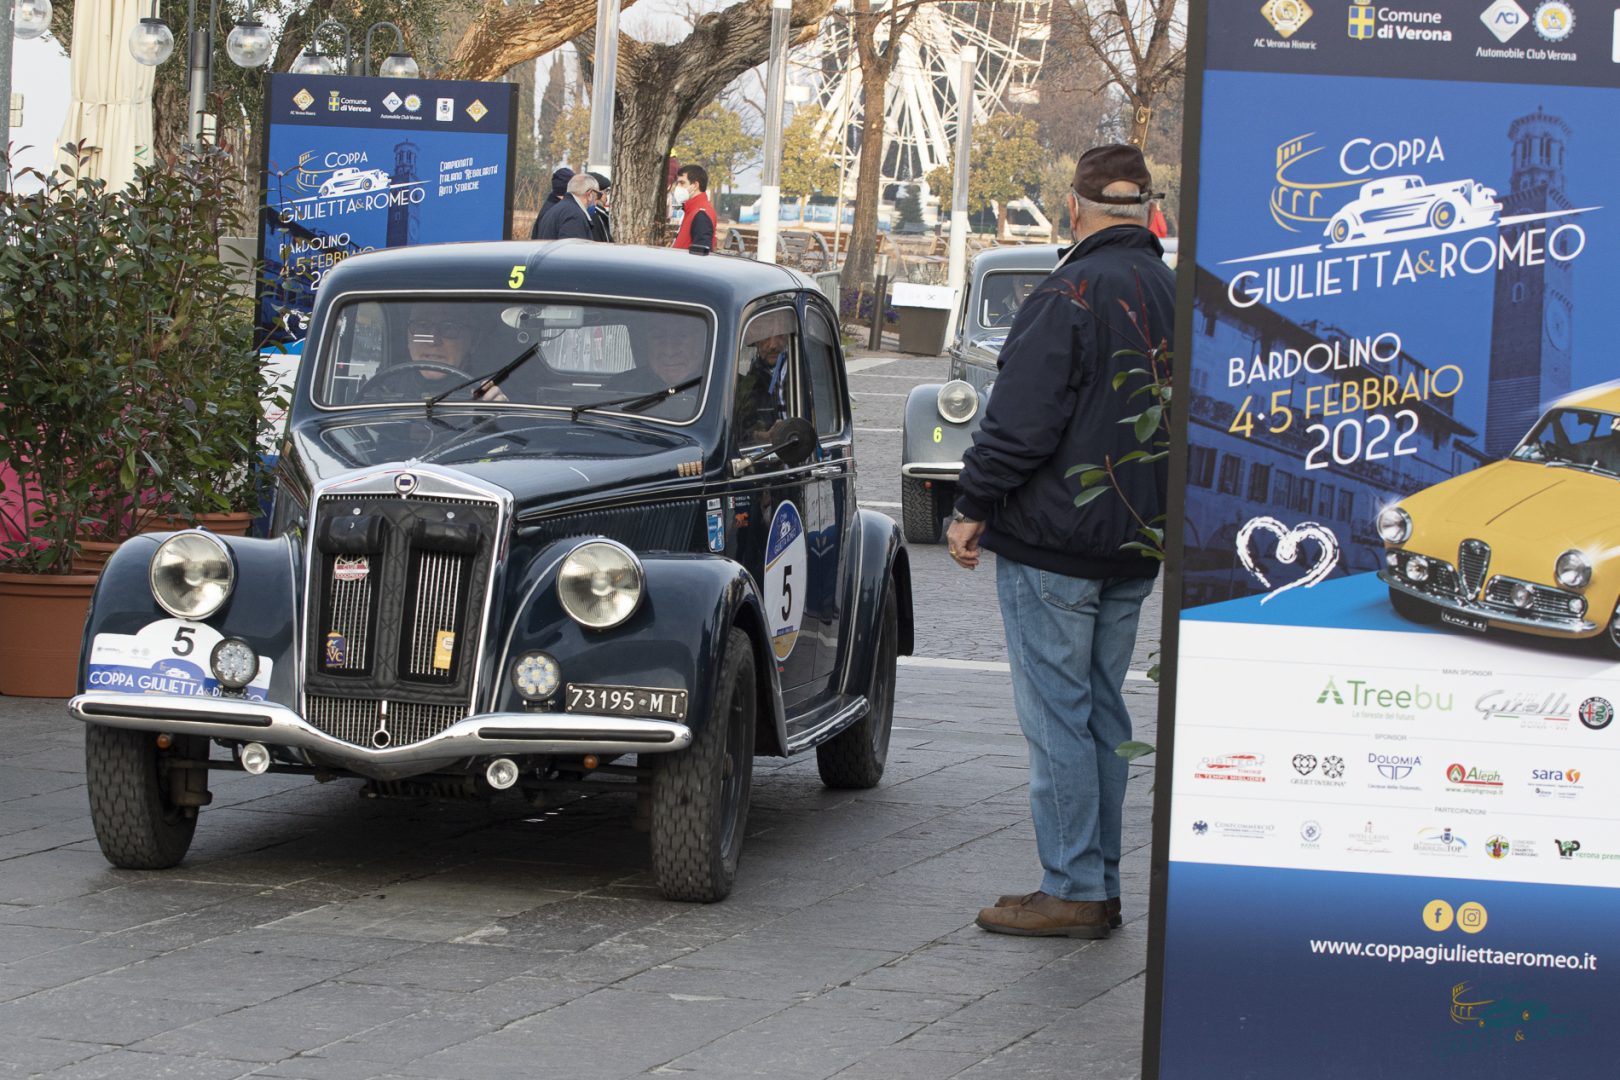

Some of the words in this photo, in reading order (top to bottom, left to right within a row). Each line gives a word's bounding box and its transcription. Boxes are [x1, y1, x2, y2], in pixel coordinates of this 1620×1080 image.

[1378, 7, 1442, 24] Comune
[1495, 12, 1519, 25] ACI
[1377, 25, 1394, 39] di
[1397, 27, 1452, 42] Verona
[1253, 38, 1265, 48] AC
[1266, 40, 1290, 48] Verona
[1291, 40, 1317, 50] Historic
[1476, 47, 1525, 59] Automobile
[1526, 49, 1546, 60] Club
[1547, 50, 1577, 61] Verona
[341, 97, 367, 105] Comune
[348, 105, 371, 113] Verona
[325, 151, 368, 168] COPPA
[1339, 136, 1445, 175] COPPA
[508, 265, 527, 289] 5
[1228, 331, 1402, 387] BARDOLINO
[1304, 364, 1464, 420] FEBBRAIO
[933, 426, 943, 443] 6
[1304, 409, 1419, 470] 2022
[781, 564, 793, 622] 5
[171, 626, 196, 656] 5
[89, 671, 134, 688] COPPA
[1442, 668, 1459, 676] MAIN
[1460, 669, 1493, 677] SPONSOR
[571, 688, 635, 711] 73195
[1346, 680, 1453, 711] Treebu
[1374, 733, 1407, 741] SPONSOR
[1368, 752, 1421, 766] DOLOMIA
[1466, 766, 1501, 782] Aleph
[1532, 769, 1563, 781] sara
[1576, 853, 1600, 862] verona
[1310, 939, 1598, 970] www.coppagiuliettaeromeo.it
